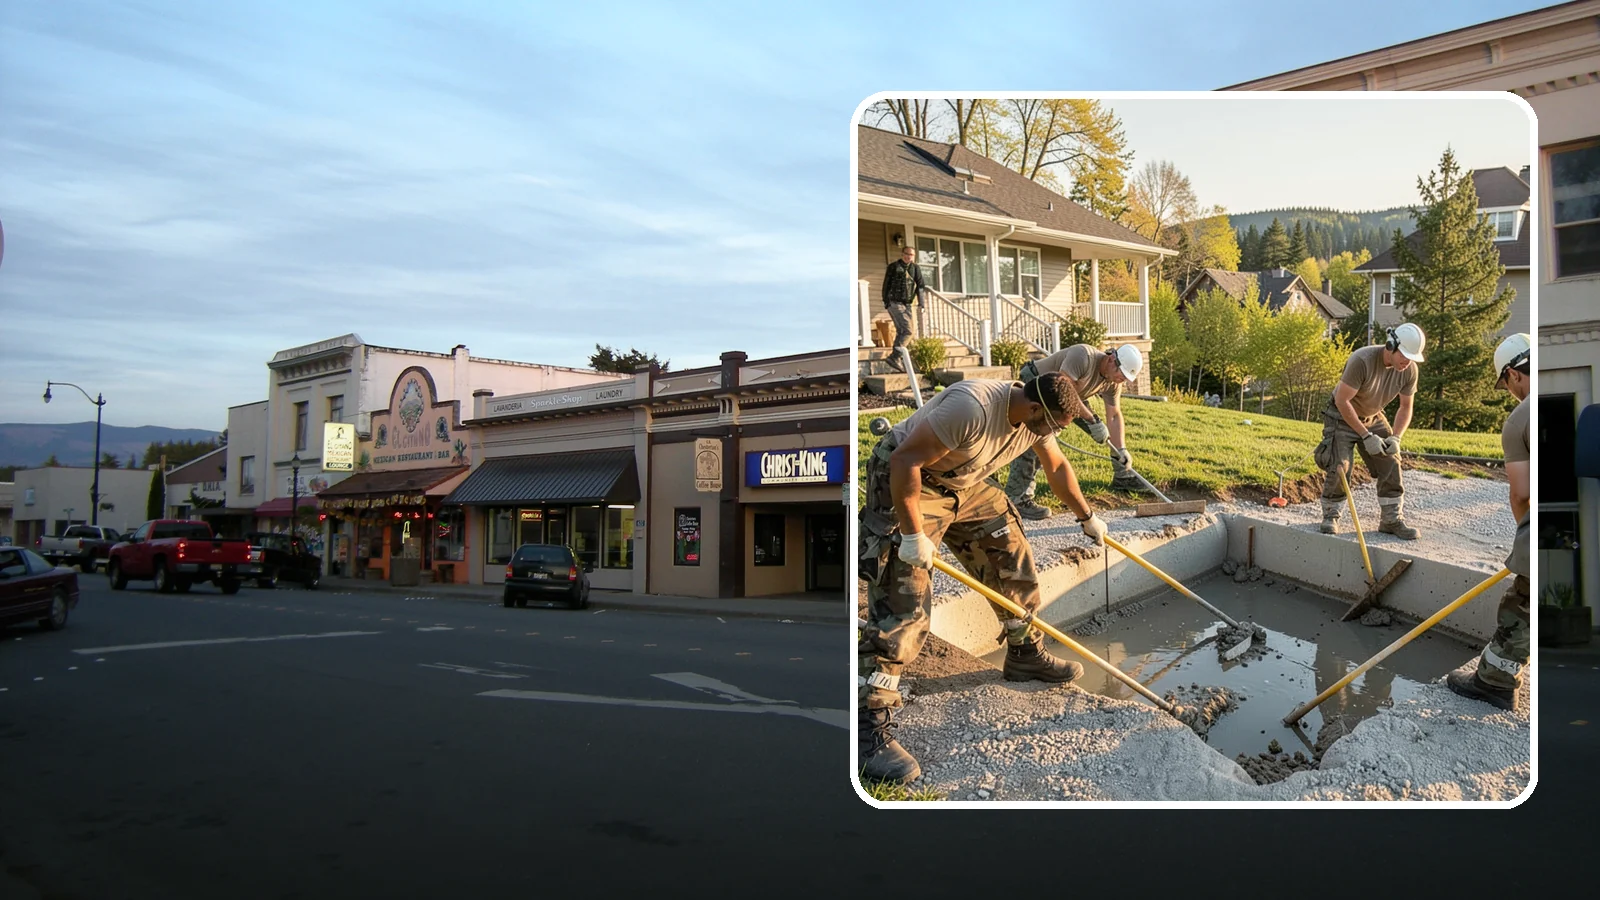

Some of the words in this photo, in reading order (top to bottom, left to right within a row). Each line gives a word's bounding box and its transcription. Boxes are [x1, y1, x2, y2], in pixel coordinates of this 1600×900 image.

[595, 388, 624, 400] LAUNDRY
[493, 402, 523, 413] LAVANDERIA
[530, 397, 561, 409] Sparkle
[562, 394, 583, 406] Shop
[373, 454, 396, 464] MEXICAN
[397, 451, 433, 462] RESTAURANT
[438, 450, 450, 459] BAR
[761, 452, 797, 478] CHRIST
[799, 450, 827, 476] KING
